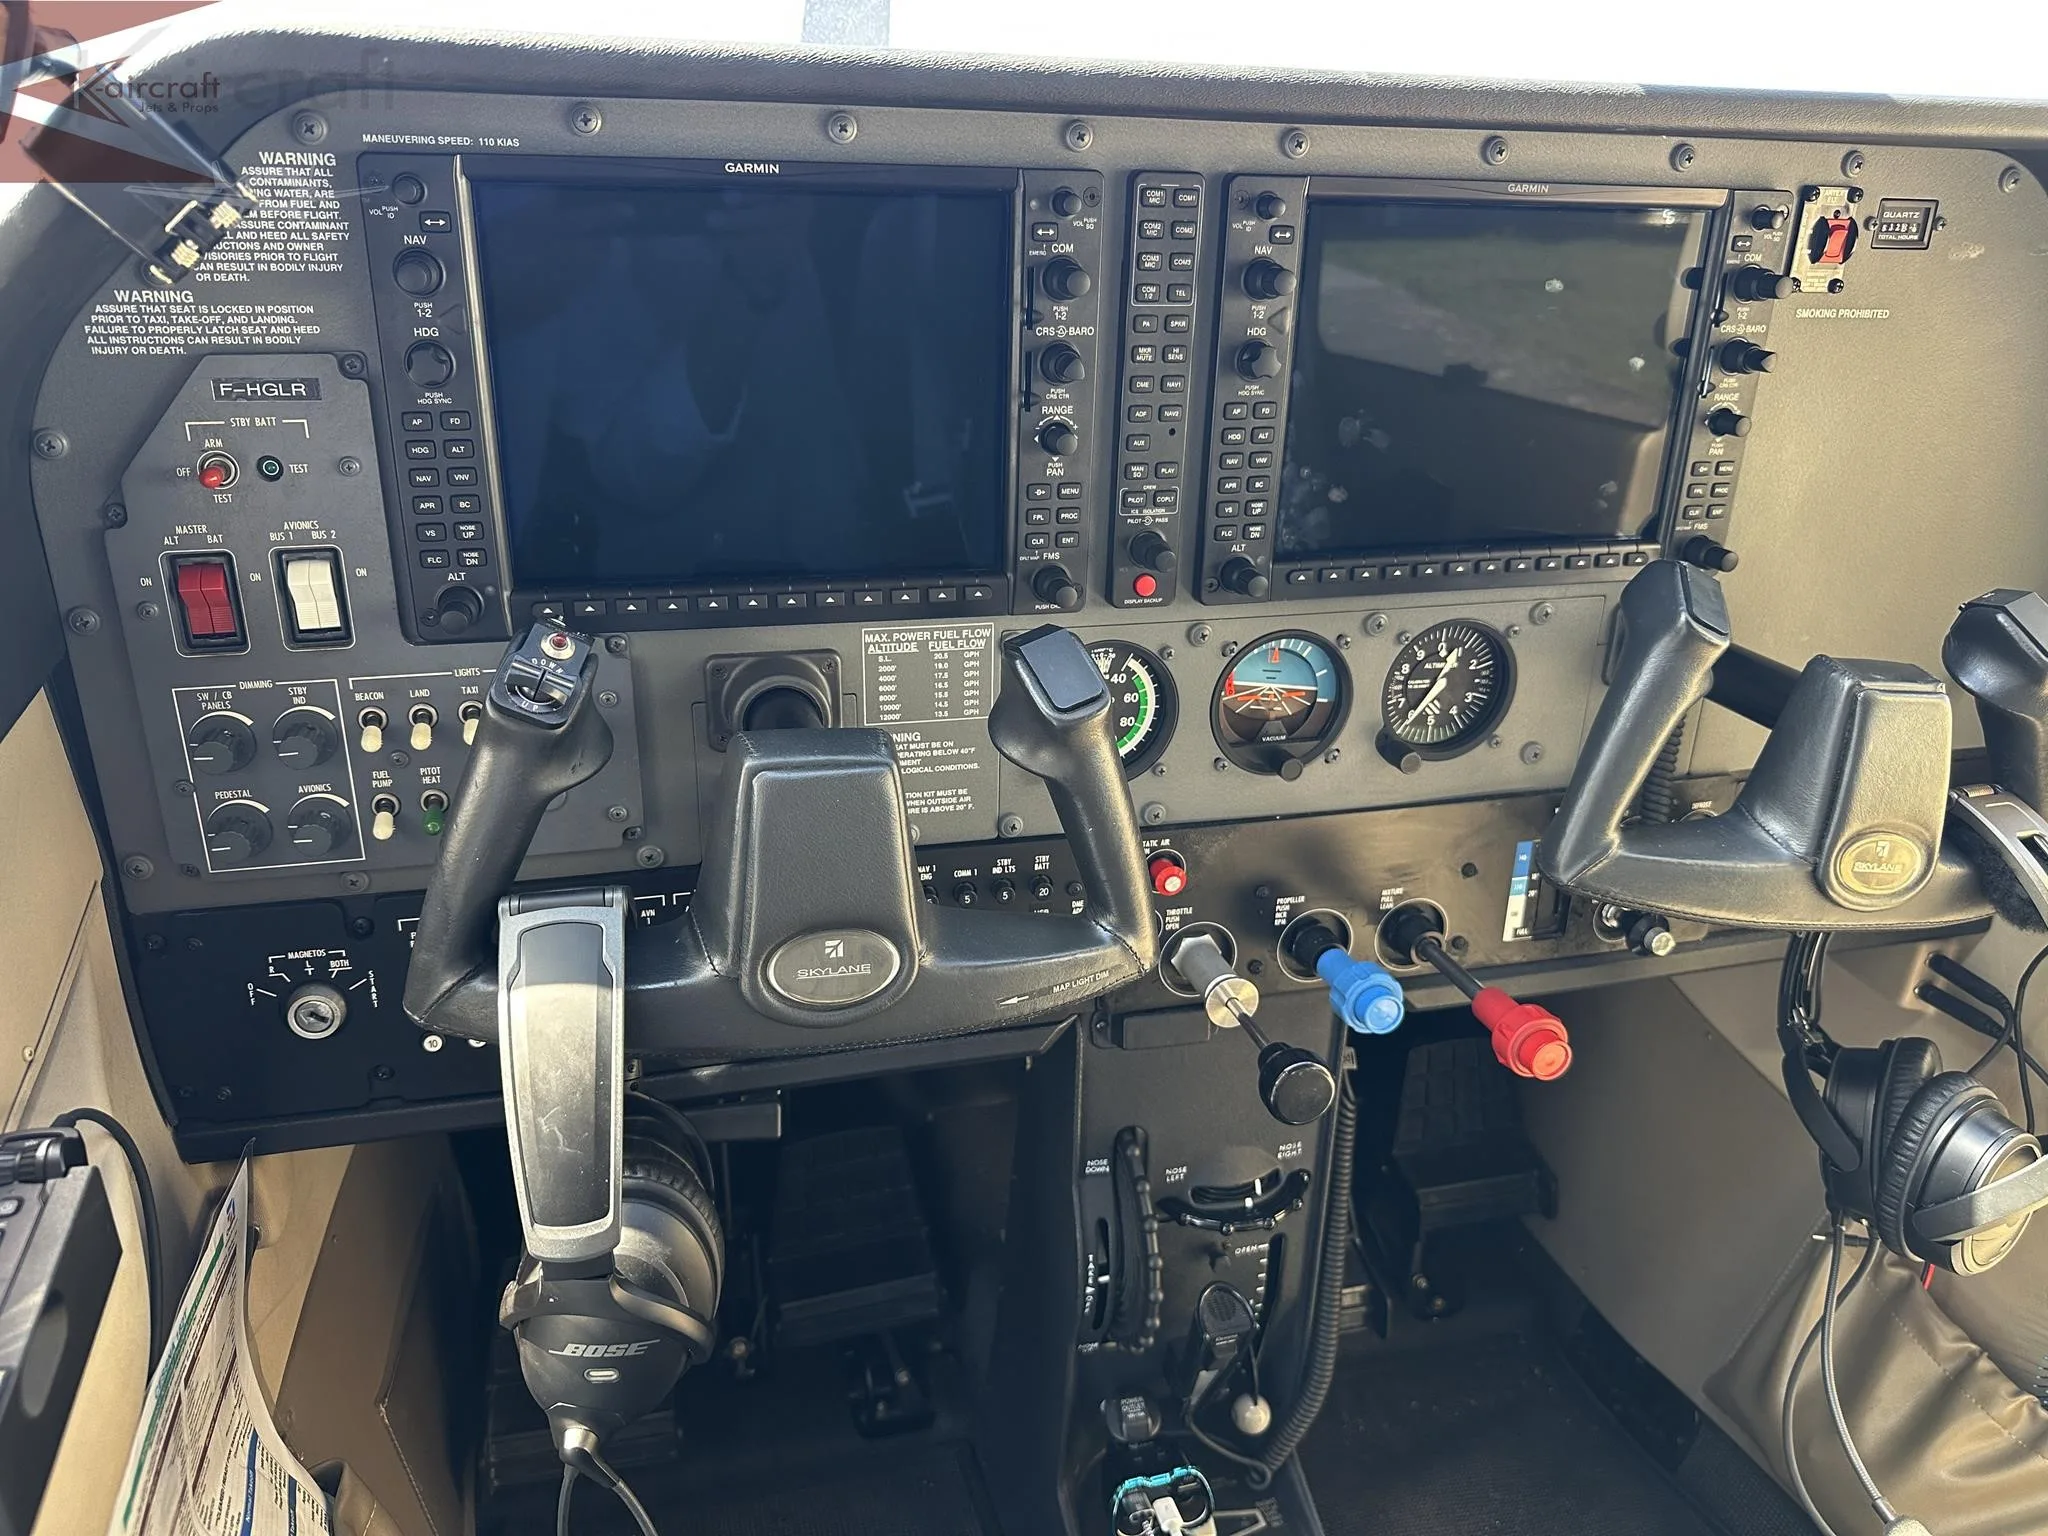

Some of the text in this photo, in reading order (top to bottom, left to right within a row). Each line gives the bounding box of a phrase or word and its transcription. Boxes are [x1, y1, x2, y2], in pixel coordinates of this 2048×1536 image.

[362, 134, 520, 146] MANEUVERING SPEED: 110 KIAS
[259, 152, 336, 166] WARNING
[242, 167, 333, 176] ASSURE THAT ALL
[725, 163, 779, 174] GARMIN
[249, 178, 332, 188] CONTAMINANTS,
[1508, 183, 1549, 193] GARMIN
[277, 188, 335, 198] WATER, ARE
[259, 200, 340, 209] FROM FUEL AND
[260, 211, 342, 220] BEFORE FLIGHT.
[404, 236, 426, 244] NAV
[1052, 244, 1074, 252] COM
[1254, 246, 1272, 254] NAV
[1744, 254, 1762, 262] COM
[216, 262, 343, 272] RESULT IN BODILY INJURY
[195, 273, 250, 282] OR DEATH.
[114, 290, 194, 303] WARNING
[96, 305, 314, 314] ASSURE THAT SEAT IS LOCKED IN POSITION
[417, 309, 432, 318] 1-2
[1796, 310, 1890, 318] SMOKING PROHIBITED
[92, 315, 298, 324] PRIOR TO TAXI, TAKE-OFF, AND LANDING.
[414, 328, 438, 336] HDG
[1036, 327, 1094, 336] CRS BARO
[1247, 328, 1266, 336] HDG
[92, 346, 187, 354] INJURY OR DEATH.
[220, 383, 306, 396] F-HGLR
[1042, 406, 1073, 414] RANGE
[230, 418, 276, 426] STBY BATT
[204, 438, 222, 448] ARM
[176, 468, 190, 476] OFF
[290, 464, 308, 473] TEST
[1046, 468, 1064, 476] PAN
[214, 494, 232, 503] TEST
[176, 525, 208, 534] MASTER
[284, 521, 318, 530] AVIONICS
[270, 530, 336, 540] BUS 1 BUS 2
[164, 535, 223, 545] ALT BAT
[356, 568, 367, 576] ON
[140, 578, 152, 586] ON
[250, 574, 262, 582] ON
[865, 628, 991, 642] MAX. POWER FUEL FLOW
[868, 638, 986, 652] ALTITUDE FUEL FLOW
[532, 658, 563, 674] DOWN
[1401, 664, 1410, 674] 8
[1469, 660, 1476, 670] 2
[455, 668, 480, 677] LIGHTS
[1111, 674, 1126, 684] 40
[240, 680, 272, 689] DIMMING
[289, 688, 307, 696] STBY
[410, 689, 430, 698] LAND
[461, 686, 478, 695] TAXI
[293, 696, 305, 704] IND
[355, 692, 384, 700] BEACON
[1124, 693, 1138, 703] 60
[202, 701, 231, 710] PANELS
[522, 701, 538, 711] UP
[1449, 706, 1457, 714] 4
[1120, 717, 1135, 726] 80
[372, 771, 389, 780] FUEL
[420, 767, 440, 776] PITOT
[372, 778, 392, 787] PUMP
[423, 775, 440, 784] HEAT
[298, 784, 331, 793] AVIONICS
[214, 790, 252, 798] PEDESTAL
[1035, 856, 1050, 864] STBY
[1034, 862, 1050, 870] BATT
[1855, 862, 1902, 871] SKYLANE
[954, 868, 978, 878] COMM 1
[1039, 888, 1049, 896] 20
[288, 950, 326, 958] MAGNETOS
[330, 960, 349, 968] BOTH
[797, 964, 870, 977] SKYLANE
[1052, 970, 1109, 994] MAP LIGHT DIM
[368, 970, 378, 1008] START
[428, 1039, 438, 1048] 10
[1166, 1166, 1186, 1174] NOSE
[1167, 1174, 1184, 1182] LEFT
[549, 1340, 660, 1358] BOSE
